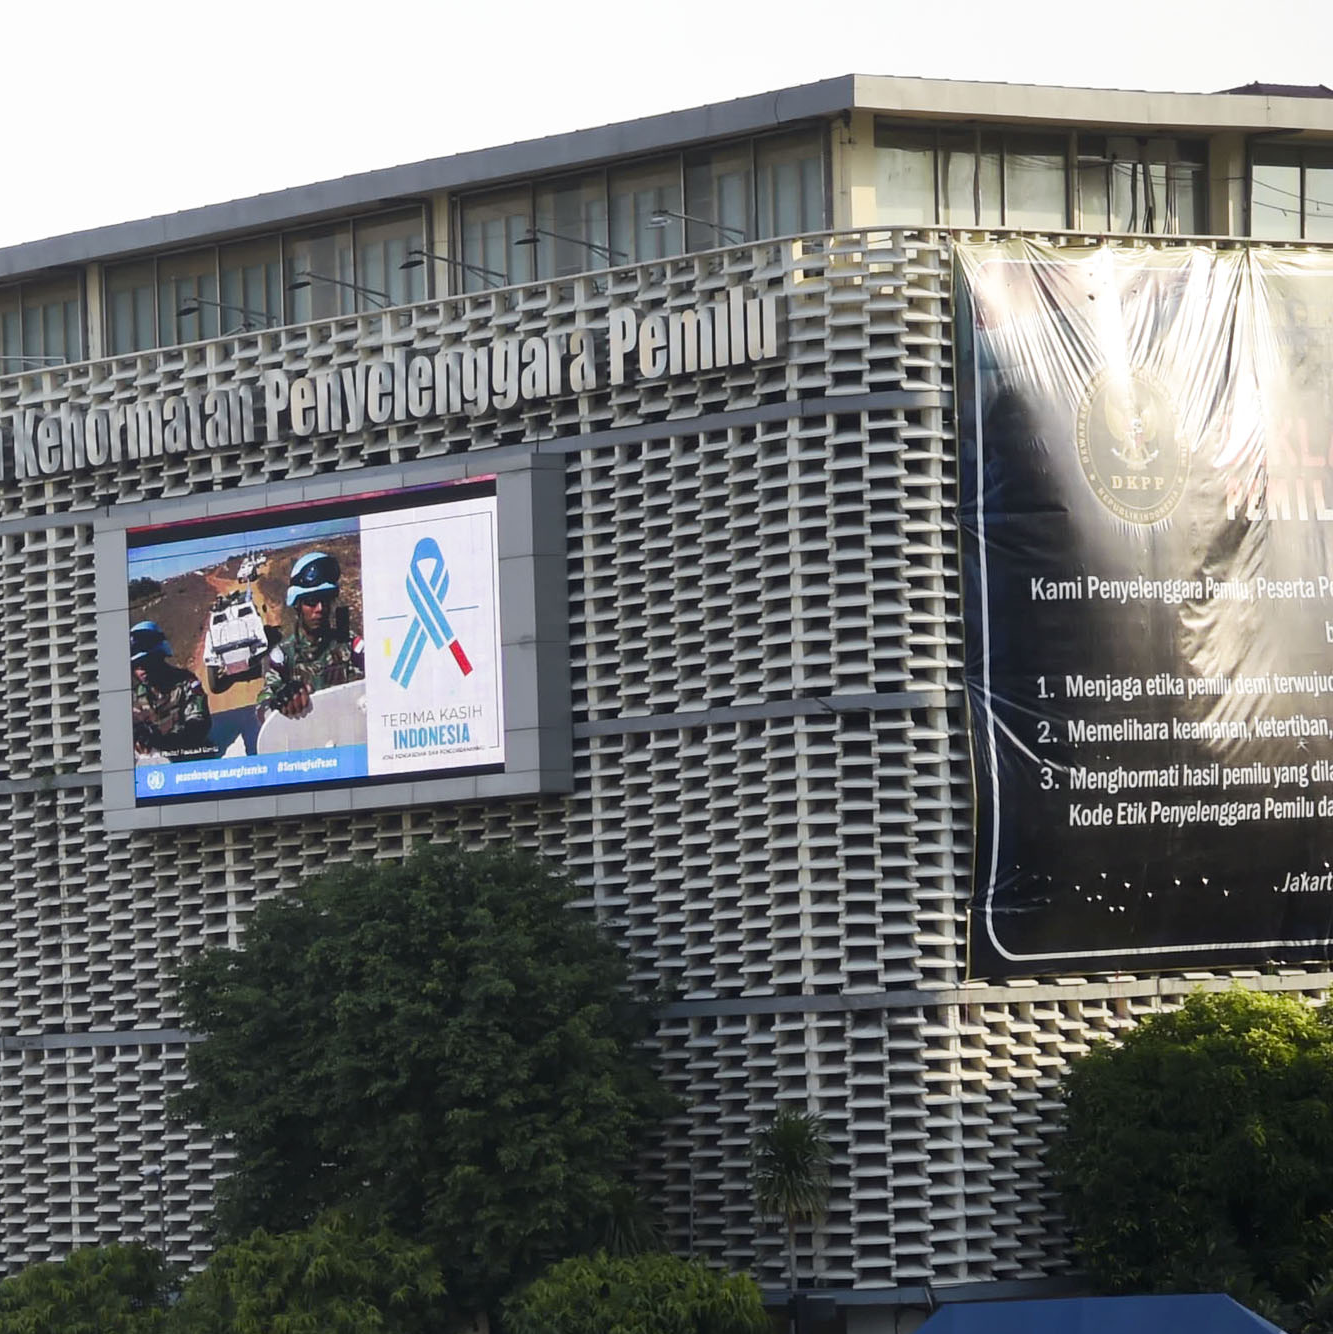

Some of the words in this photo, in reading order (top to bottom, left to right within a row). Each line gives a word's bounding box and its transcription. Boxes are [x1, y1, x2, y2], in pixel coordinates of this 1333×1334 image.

[12, 385, 255, 479] Kehormatan
[264, 328, 596, 442] Penyelenggara
[609, 286, 778, 386] Pemilu
[1111, 475, 1164, 490] DKPP
[1031, 577, 1082, 600] Kami
[1087, 576, 1203, 604] Penyelenggara
[1205, 577, 1254, 601] Pemilu,
[1257, 576, 1315, 599] Peserta
[1037, 676, 1055, 698] 1.
[1066, 675, 1142, 701] Menjaga
[1146, 673, 1183, 696] etika
[1188, 675, 1232, 699] pemilu
[1235, 675, 1271, 695] demi
[381, 710, 435, 727] TERIMA
[440, 704, 483, 720] KASIH
[1037, 722, 1058, 743] 2.
[1067, 718, 1169, 743] Memelihara
[1173, 718, 1252, 742] keamanan,
[1255, 715, 1333, 739] ketertiban,
[393, 723, 470, 750] INDONESIA
[1040, 767, 1060, 790] 3.
[1070, 765, 1179, 794] Menghormati
[1183, 763, 1219, 786] hasil
[1222, 762, 1271, 790] pemilu
[1274, 763, 1309, 788] yang
[1069, 803, 1113, 826] Kode
[1117, 801, 1147, 824] Etik
[1150, 800, 1261, 827] Penyelenggara
[1264, 797, 1314, 820] Pemilu
